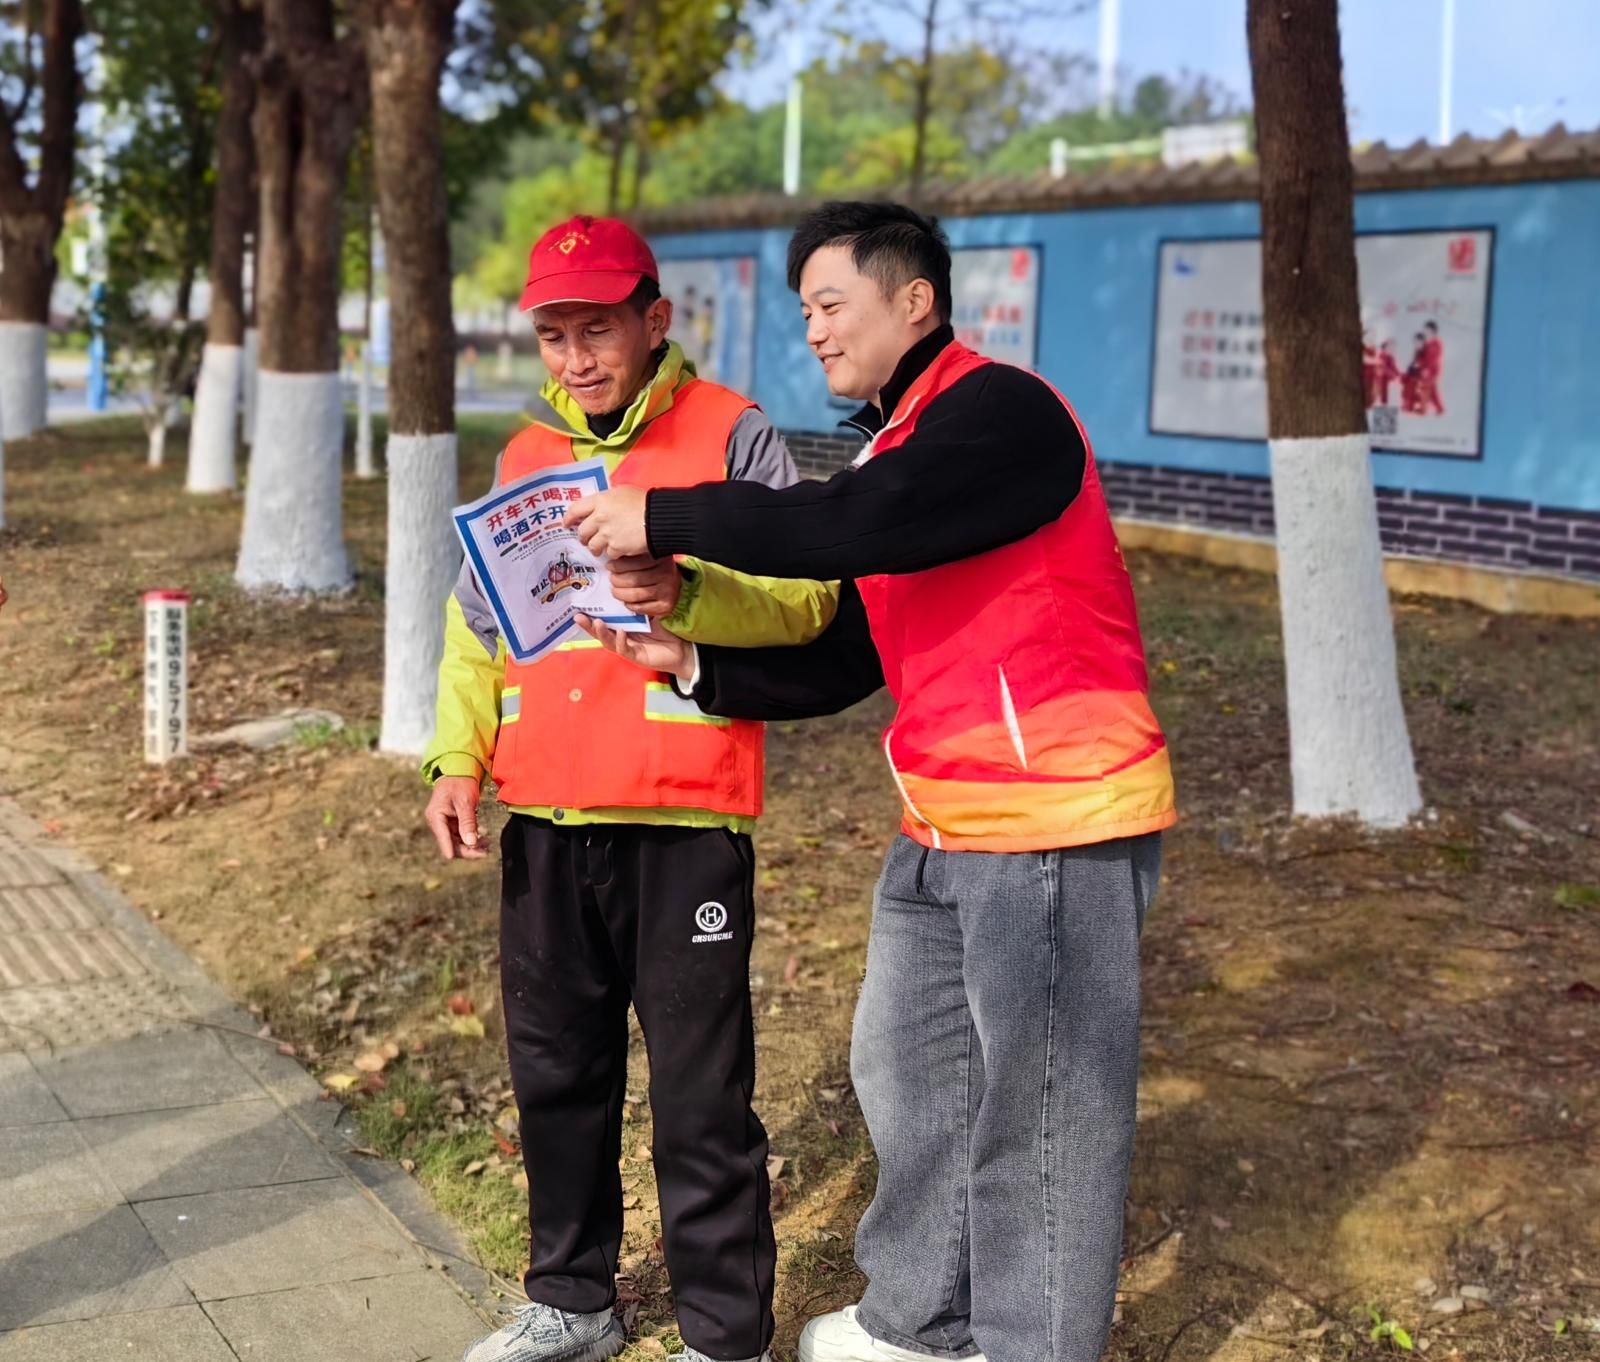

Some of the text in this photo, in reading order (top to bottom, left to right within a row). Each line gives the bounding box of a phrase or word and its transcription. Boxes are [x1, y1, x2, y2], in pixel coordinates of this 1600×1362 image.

[486, 488, 582, 532] 开车不喝酒
